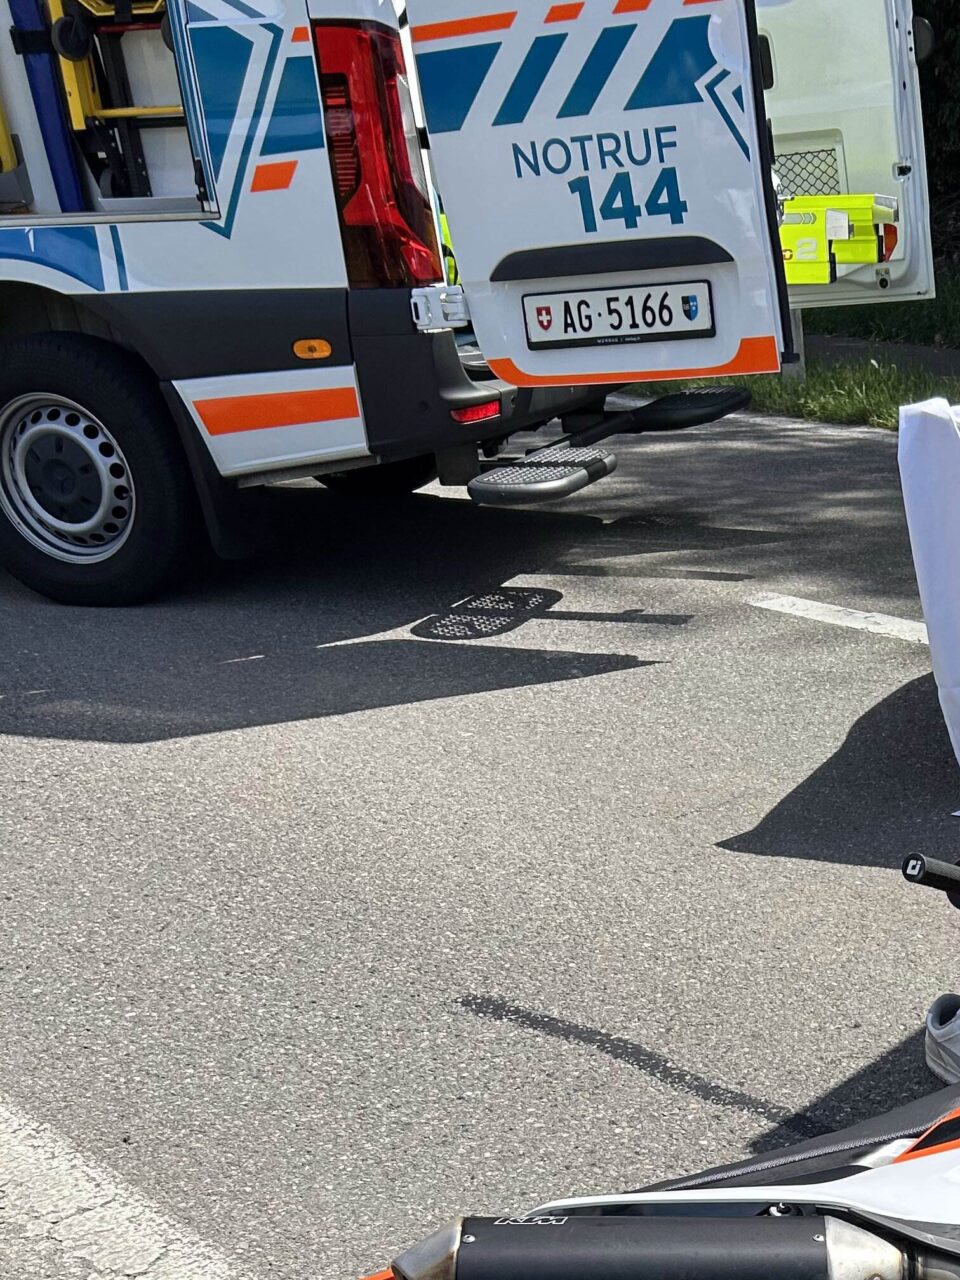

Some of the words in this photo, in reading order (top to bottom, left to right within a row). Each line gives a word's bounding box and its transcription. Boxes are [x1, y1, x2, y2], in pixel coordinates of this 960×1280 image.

[512, 125, 677, 178] NOTRUF
[567, 167, 688, 232] 144
[796, 238, 818, 260] 2
